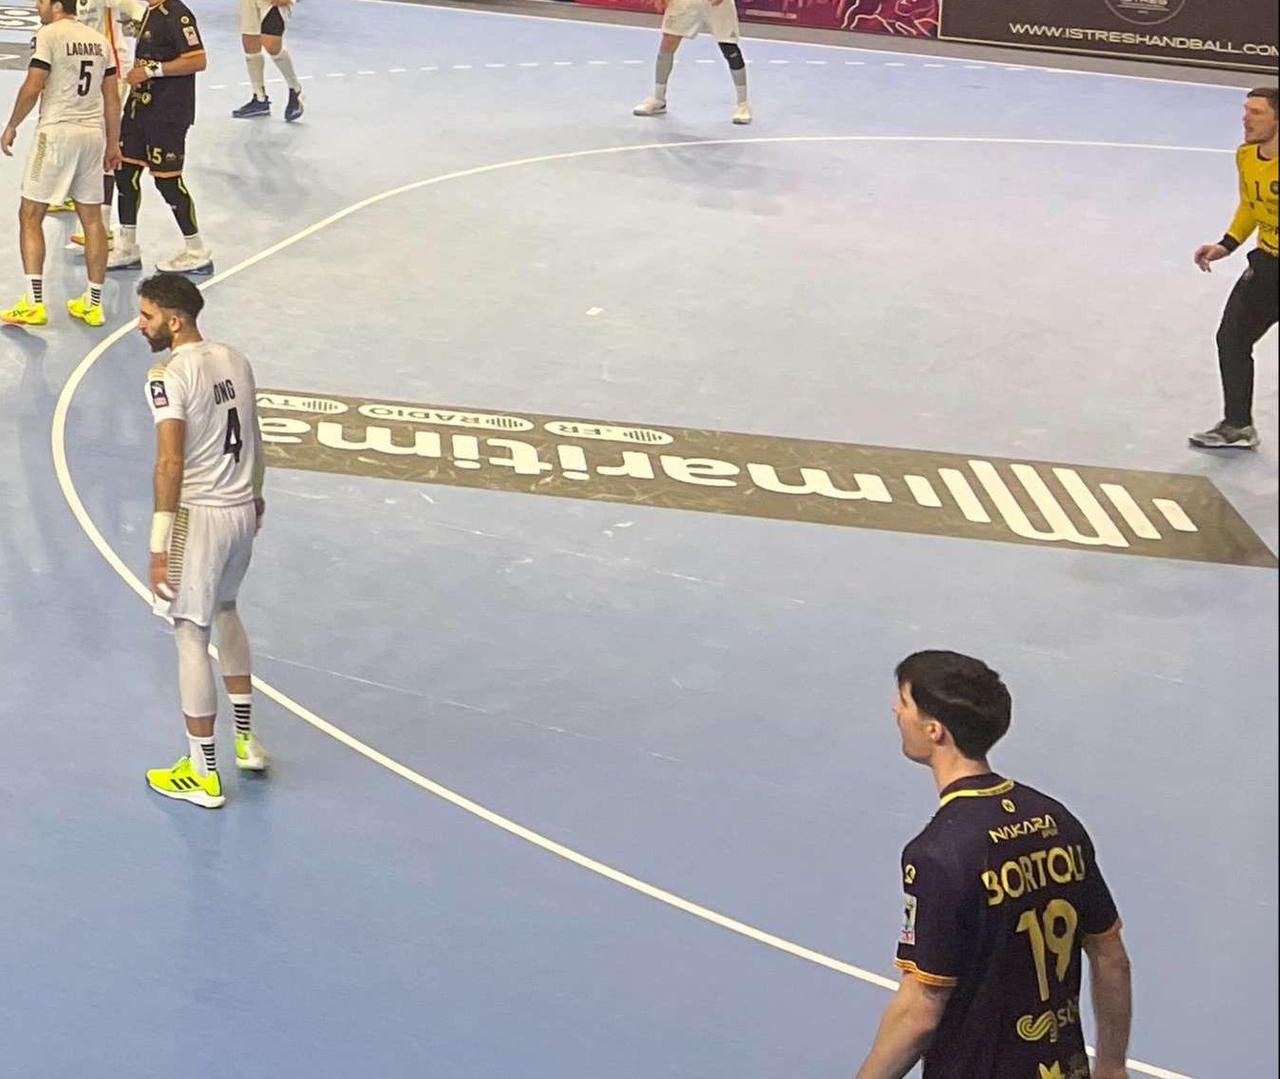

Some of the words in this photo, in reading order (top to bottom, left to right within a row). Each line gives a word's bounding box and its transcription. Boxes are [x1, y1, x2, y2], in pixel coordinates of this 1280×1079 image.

[66, 41, 104, 58] LAGARDE
[77, 60, 94, 97] 5
[213, 378, 236, 405] ONG
[367, 406, 483, 428] RADIO
[223, 406, 243, 464] 4
[258, 415, 893, 503] maritima
[988, 813, 1058, 844] NAKARA
[1015, 898, 1079, 1003] 19
